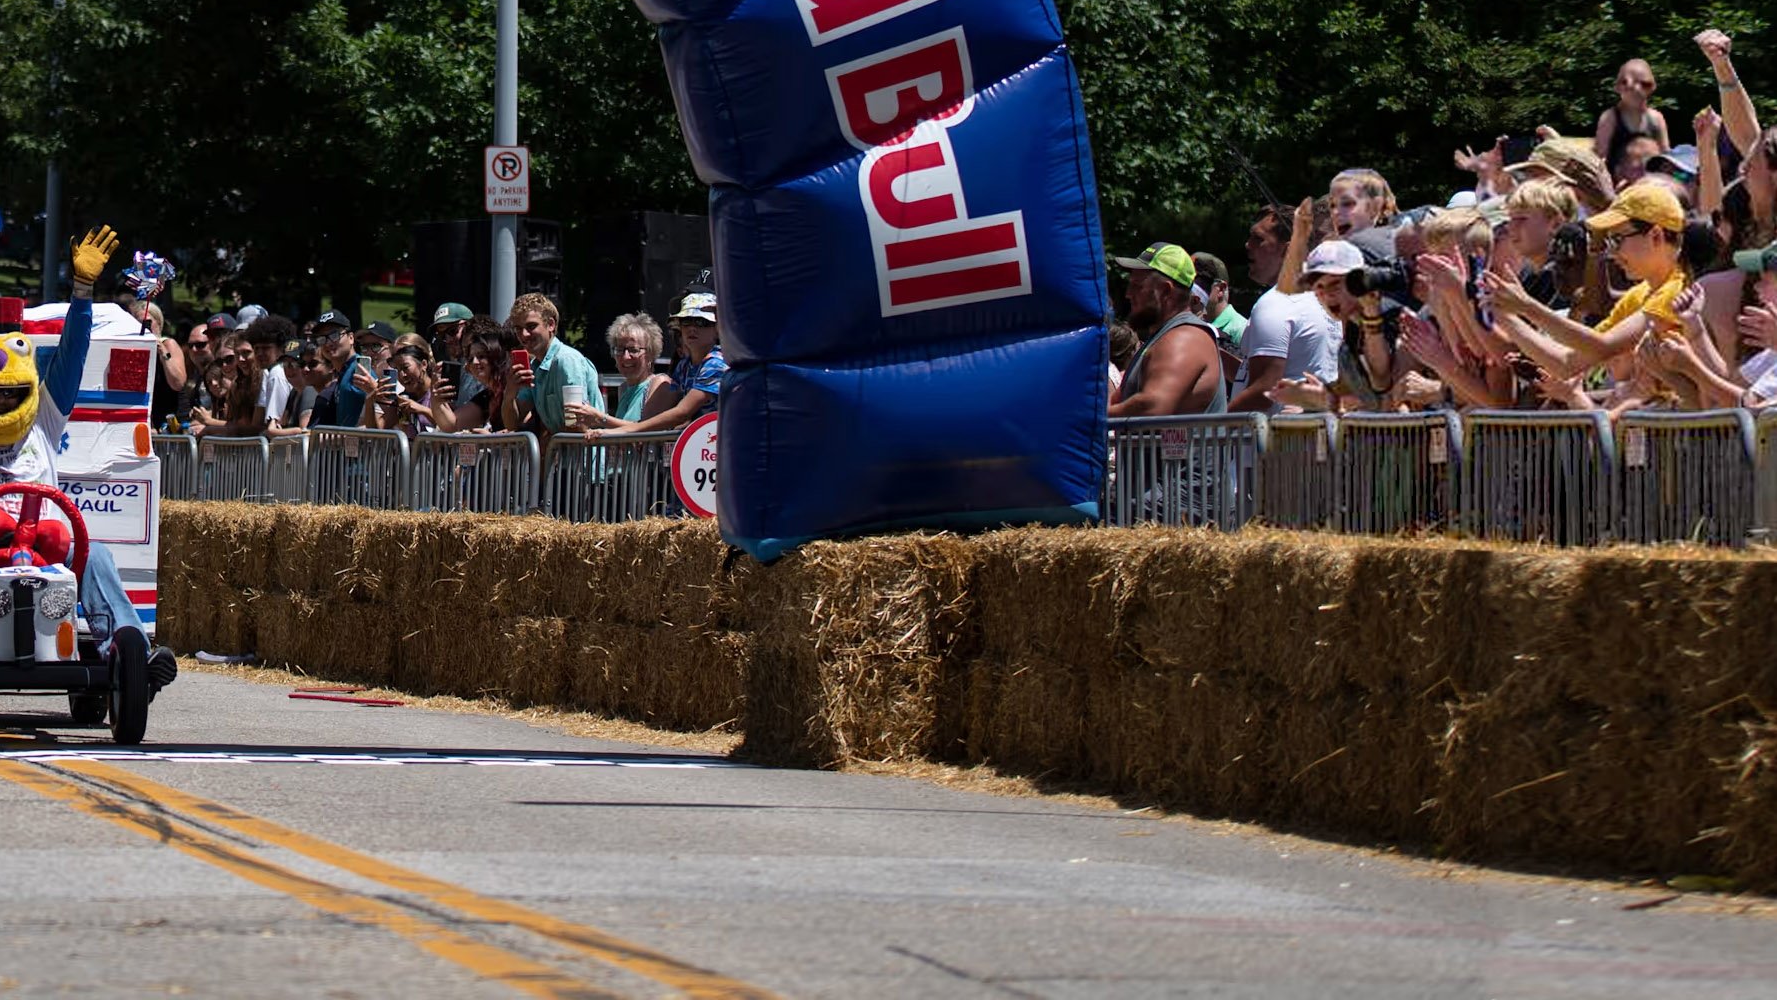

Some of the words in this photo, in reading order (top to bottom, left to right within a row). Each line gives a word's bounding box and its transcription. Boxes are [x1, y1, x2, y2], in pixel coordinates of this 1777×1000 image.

[830, 31, 1029, 313] Bull
[493, 197, 523, 207] ANYTIME
[57, 481, 139, 497] 76-002
